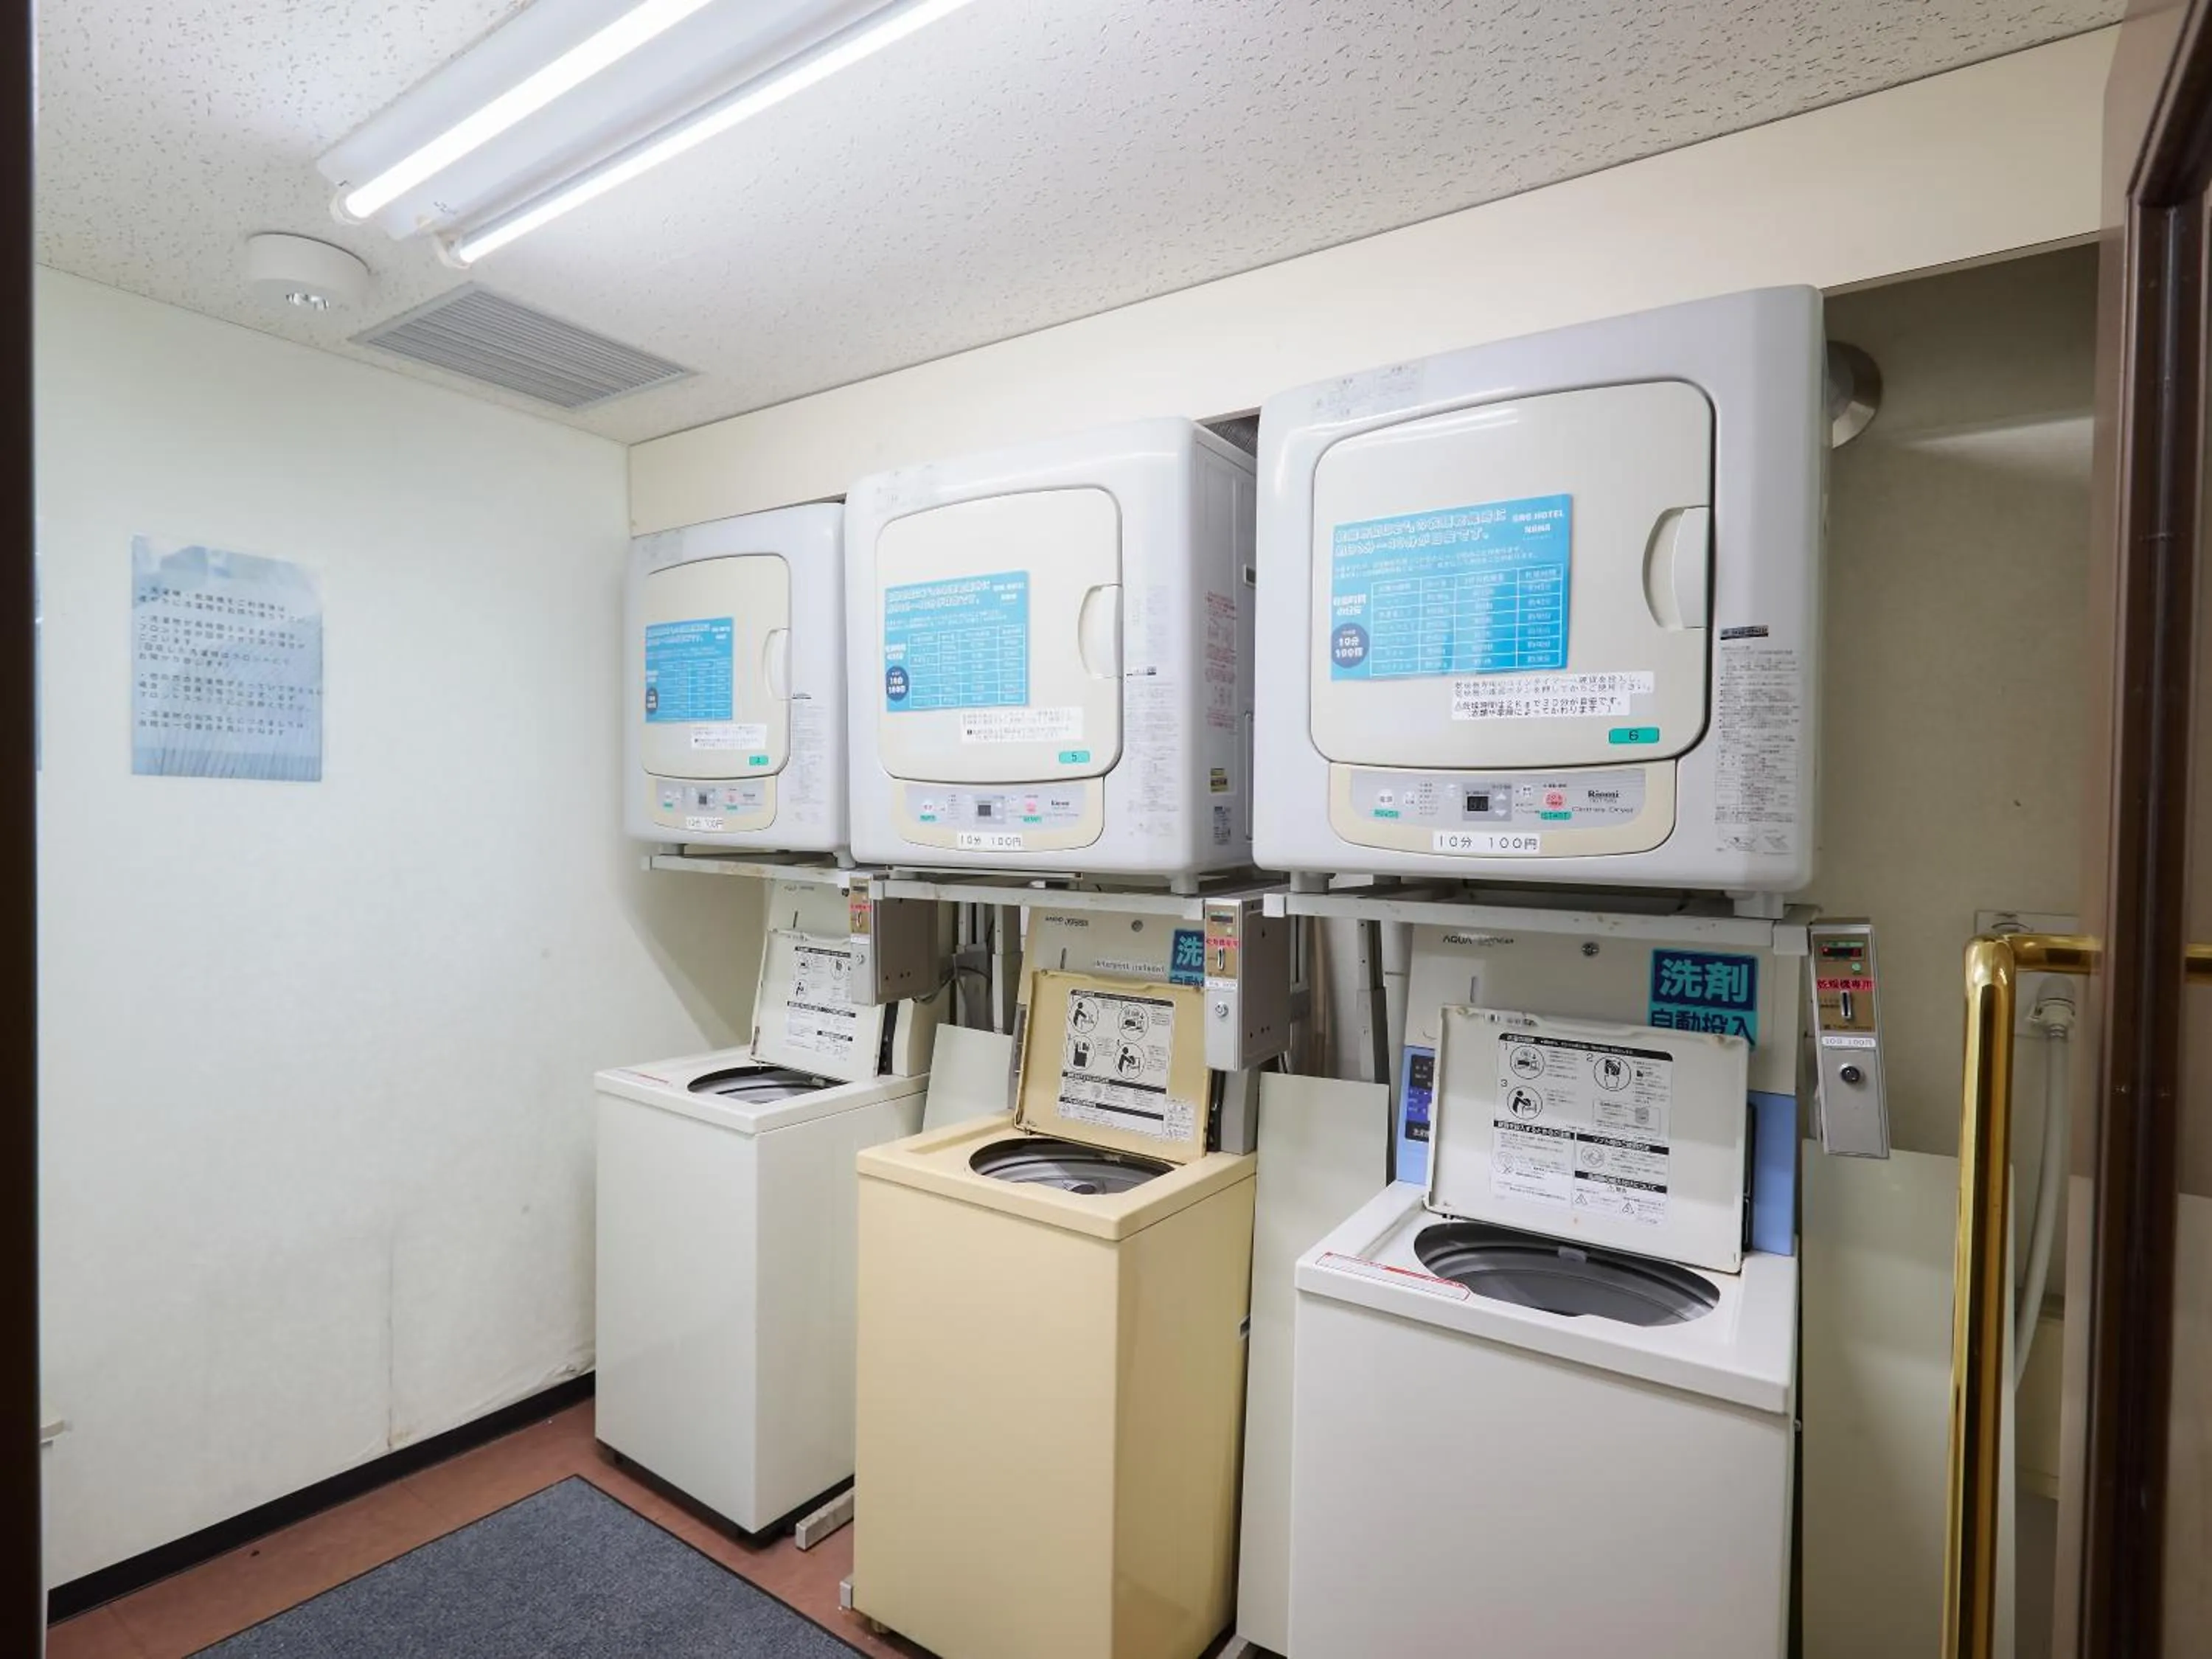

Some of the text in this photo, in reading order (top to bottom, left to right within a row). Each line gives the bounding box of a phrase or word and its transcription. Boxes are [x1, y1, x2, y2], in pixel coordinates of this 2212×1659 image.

[1629, 730, 1638, 740] 6
[1071, 753, 1077, 762] 5
[1439, 837, 1539, 850] 10分 100円
[1177, 936, 1203, 967] 洗
[1660, 959, 1748, 1004] 洗剤
[1818, 978, 1872, 990] 乾燥機専用
[1651, 1008, 1756, 1046] 自動投入
[1586, 1053, 1593, 1062] 2
[1500, 1079, 1508, 1088] 3
